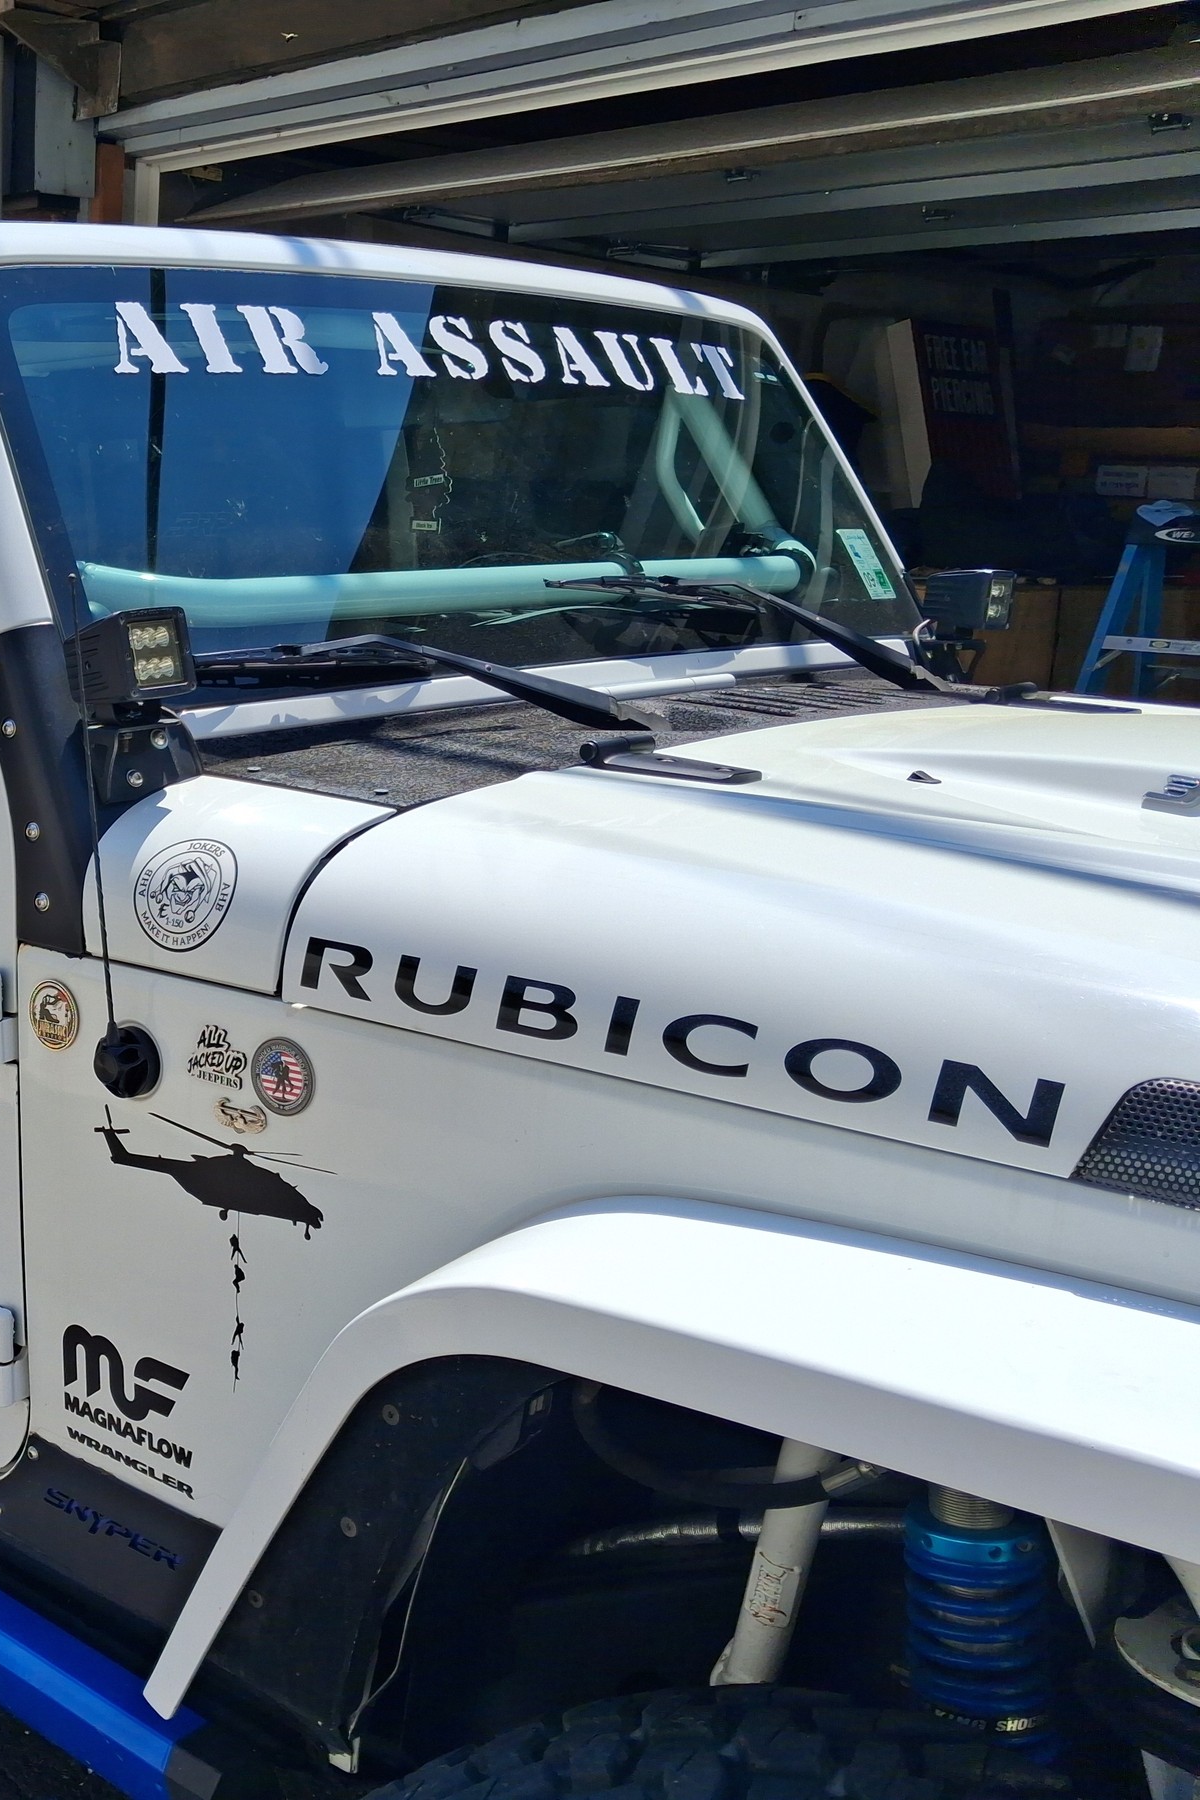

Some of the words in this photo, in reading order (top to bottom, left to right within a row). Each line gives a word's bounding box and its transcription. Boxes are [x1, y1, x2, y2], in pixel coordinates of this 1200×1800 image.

[114, 301, 329, 375] AIR
[375, 312, 745, 400] ASSAULT
[924, 334, 960, 371] FREE
[187, 842, 225, 858] JOKERS
[138, 869, 154, 898] AHB
[214, 882, 231, 912] AHB
[141, 911, 161, 938] MAKE
[161, 933, 171, 944] IT
[172, 922, 211, 946] HAPPEN!
[197, 1028, 225, 1049] ALL
[300, 936, 1066, 1147] RUBICON
[187, 1051, 224, 1073] JACKED
[225, 1054, 243, 1075] UP
[197, 1070, 238, 1089] JEEPERS
[64, 1391, 193, 1469] MAGNAFLOW
[66, 1425, 195, 1500] WRANGLER
[43, 1487, 186, 1571] SNYPER
